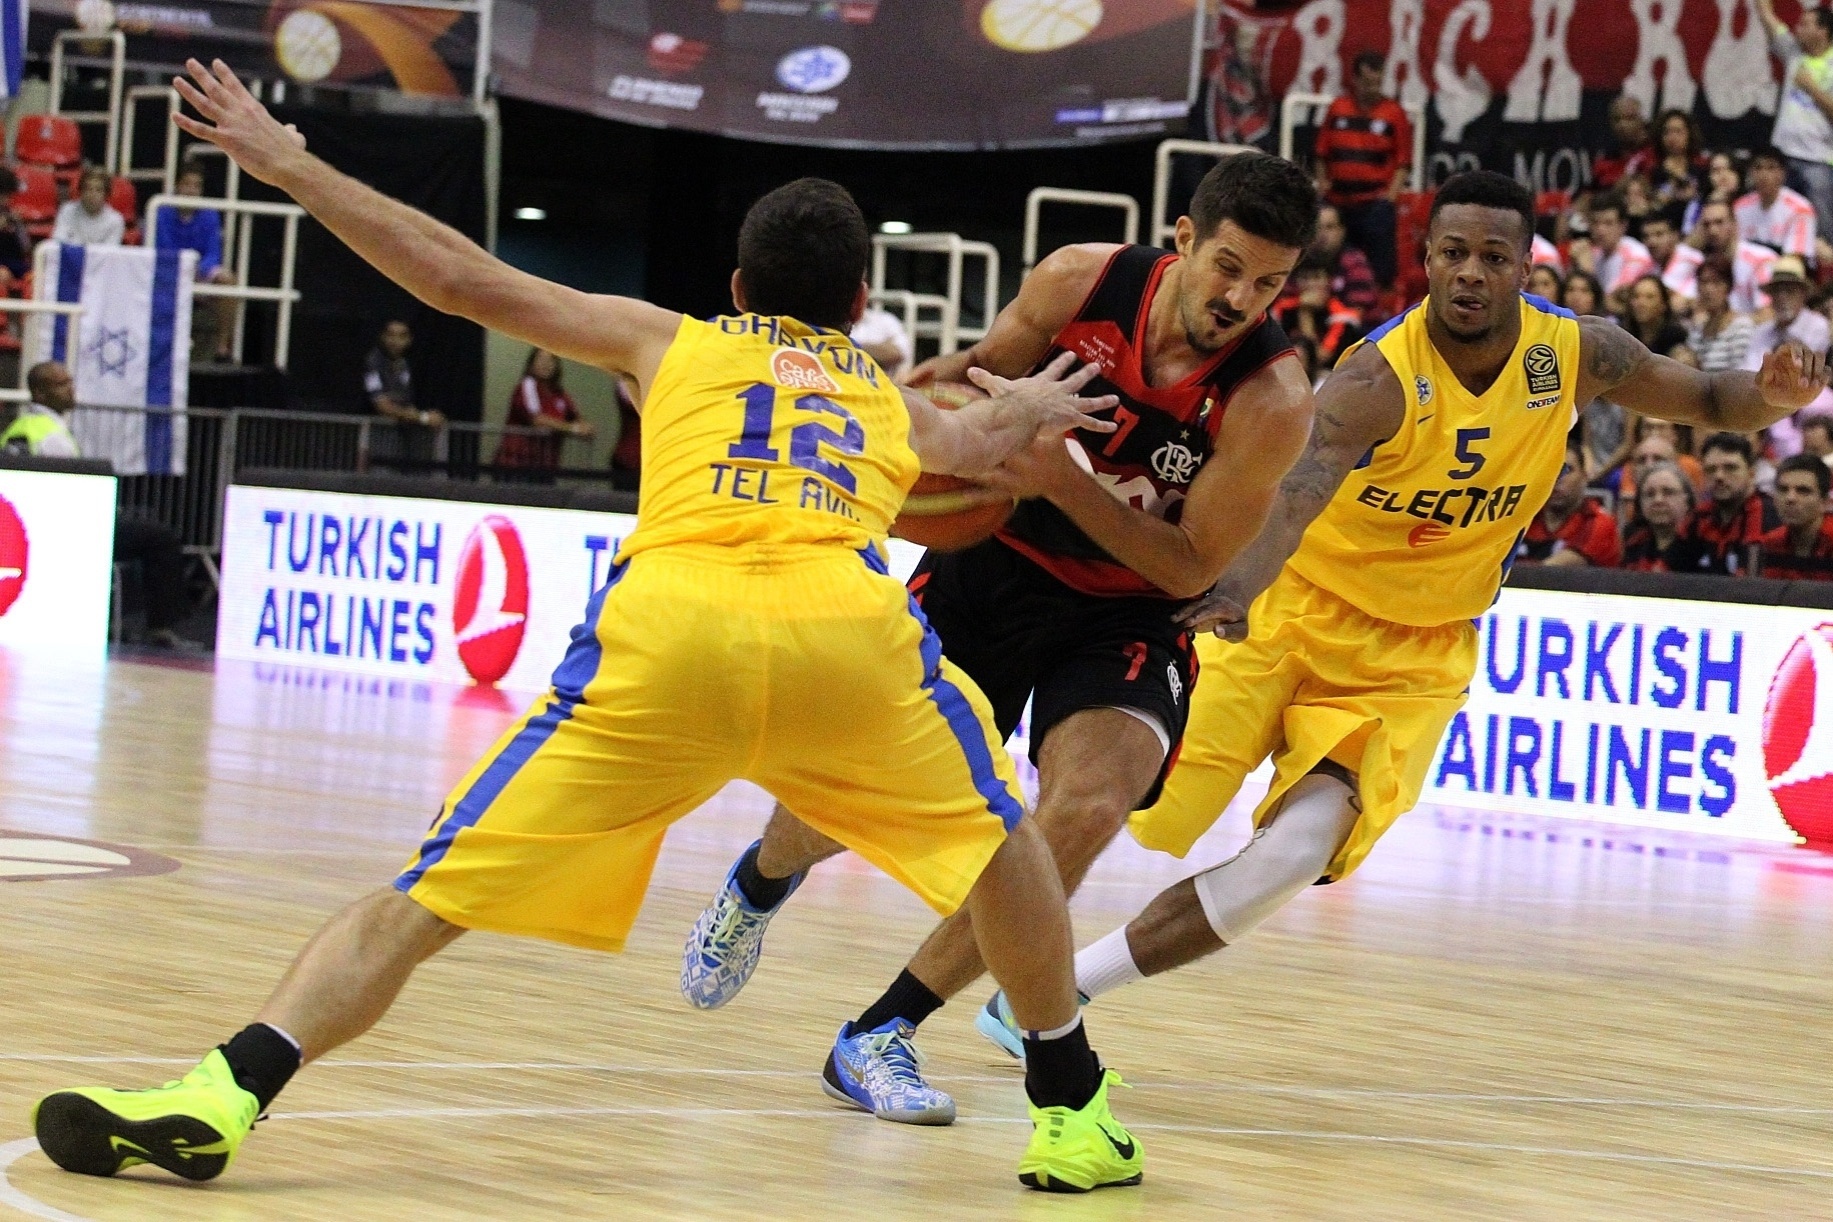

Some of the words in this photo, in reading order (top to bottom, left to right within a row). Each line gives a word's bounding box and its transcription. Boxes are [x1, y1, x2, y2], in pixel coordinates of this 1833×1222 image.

[727, 381, 865, 496] 12
[1103, 405, 1140, 456] 7
[1447, 426, 1490, 480] 5
[709, 463, 780, 504] TEL
[1357, 484, 1527, 528] ELECTRA
[263, 510, 442, 585] TURKISH
[255, 588, 437, 664] AIRLINES
[1123, 642, 1147, 680] 7
[1473, 612, 1744, 714] URKISH
[1435, 711, 1737, 818] AIRLINES
